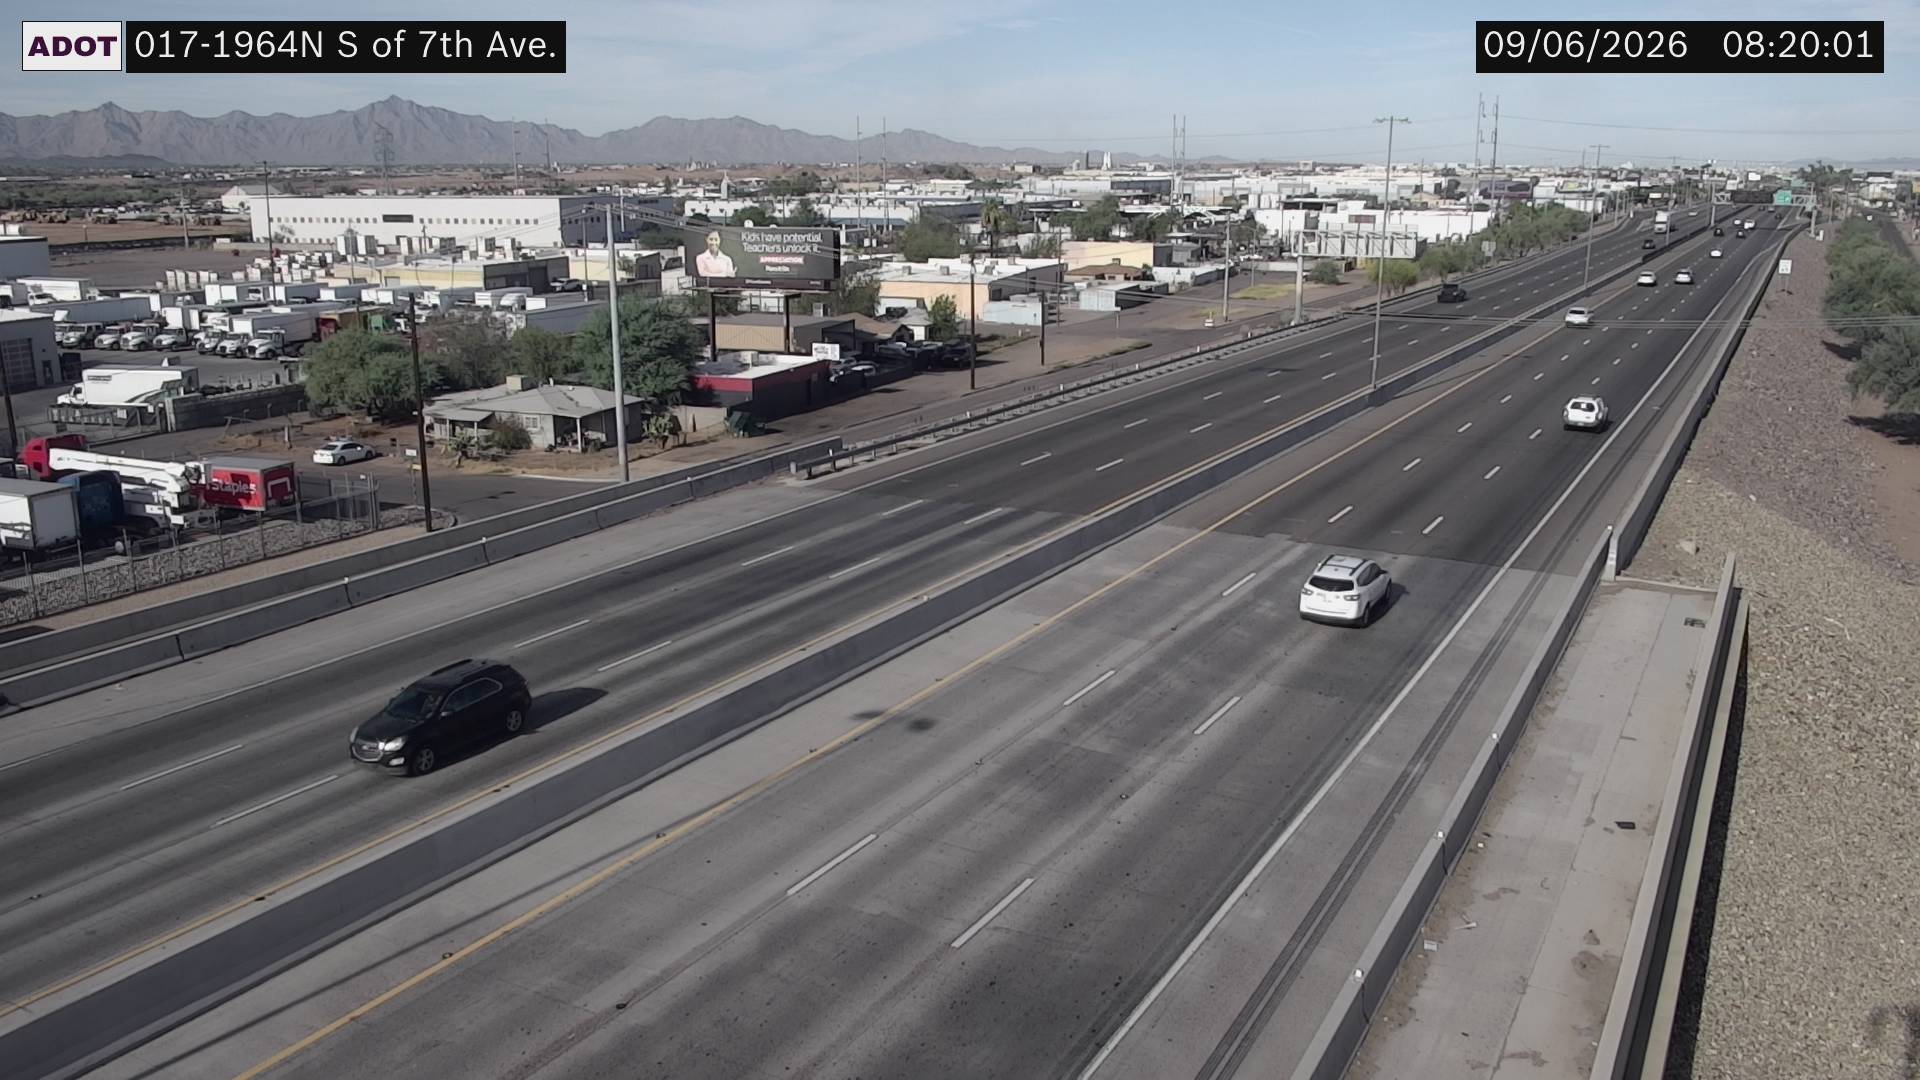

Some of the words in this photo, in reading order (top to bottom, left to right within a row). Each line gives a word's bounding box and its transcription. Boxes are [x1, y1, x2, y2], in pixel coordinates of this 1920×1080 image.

[741, 232, 760, 242] Kids
[761, 232, 782, 242] have
[743, 242, 781, 253] Teachers
[782, 243, 811, 253] unlock
[212, 477, 257, 496] Staples
